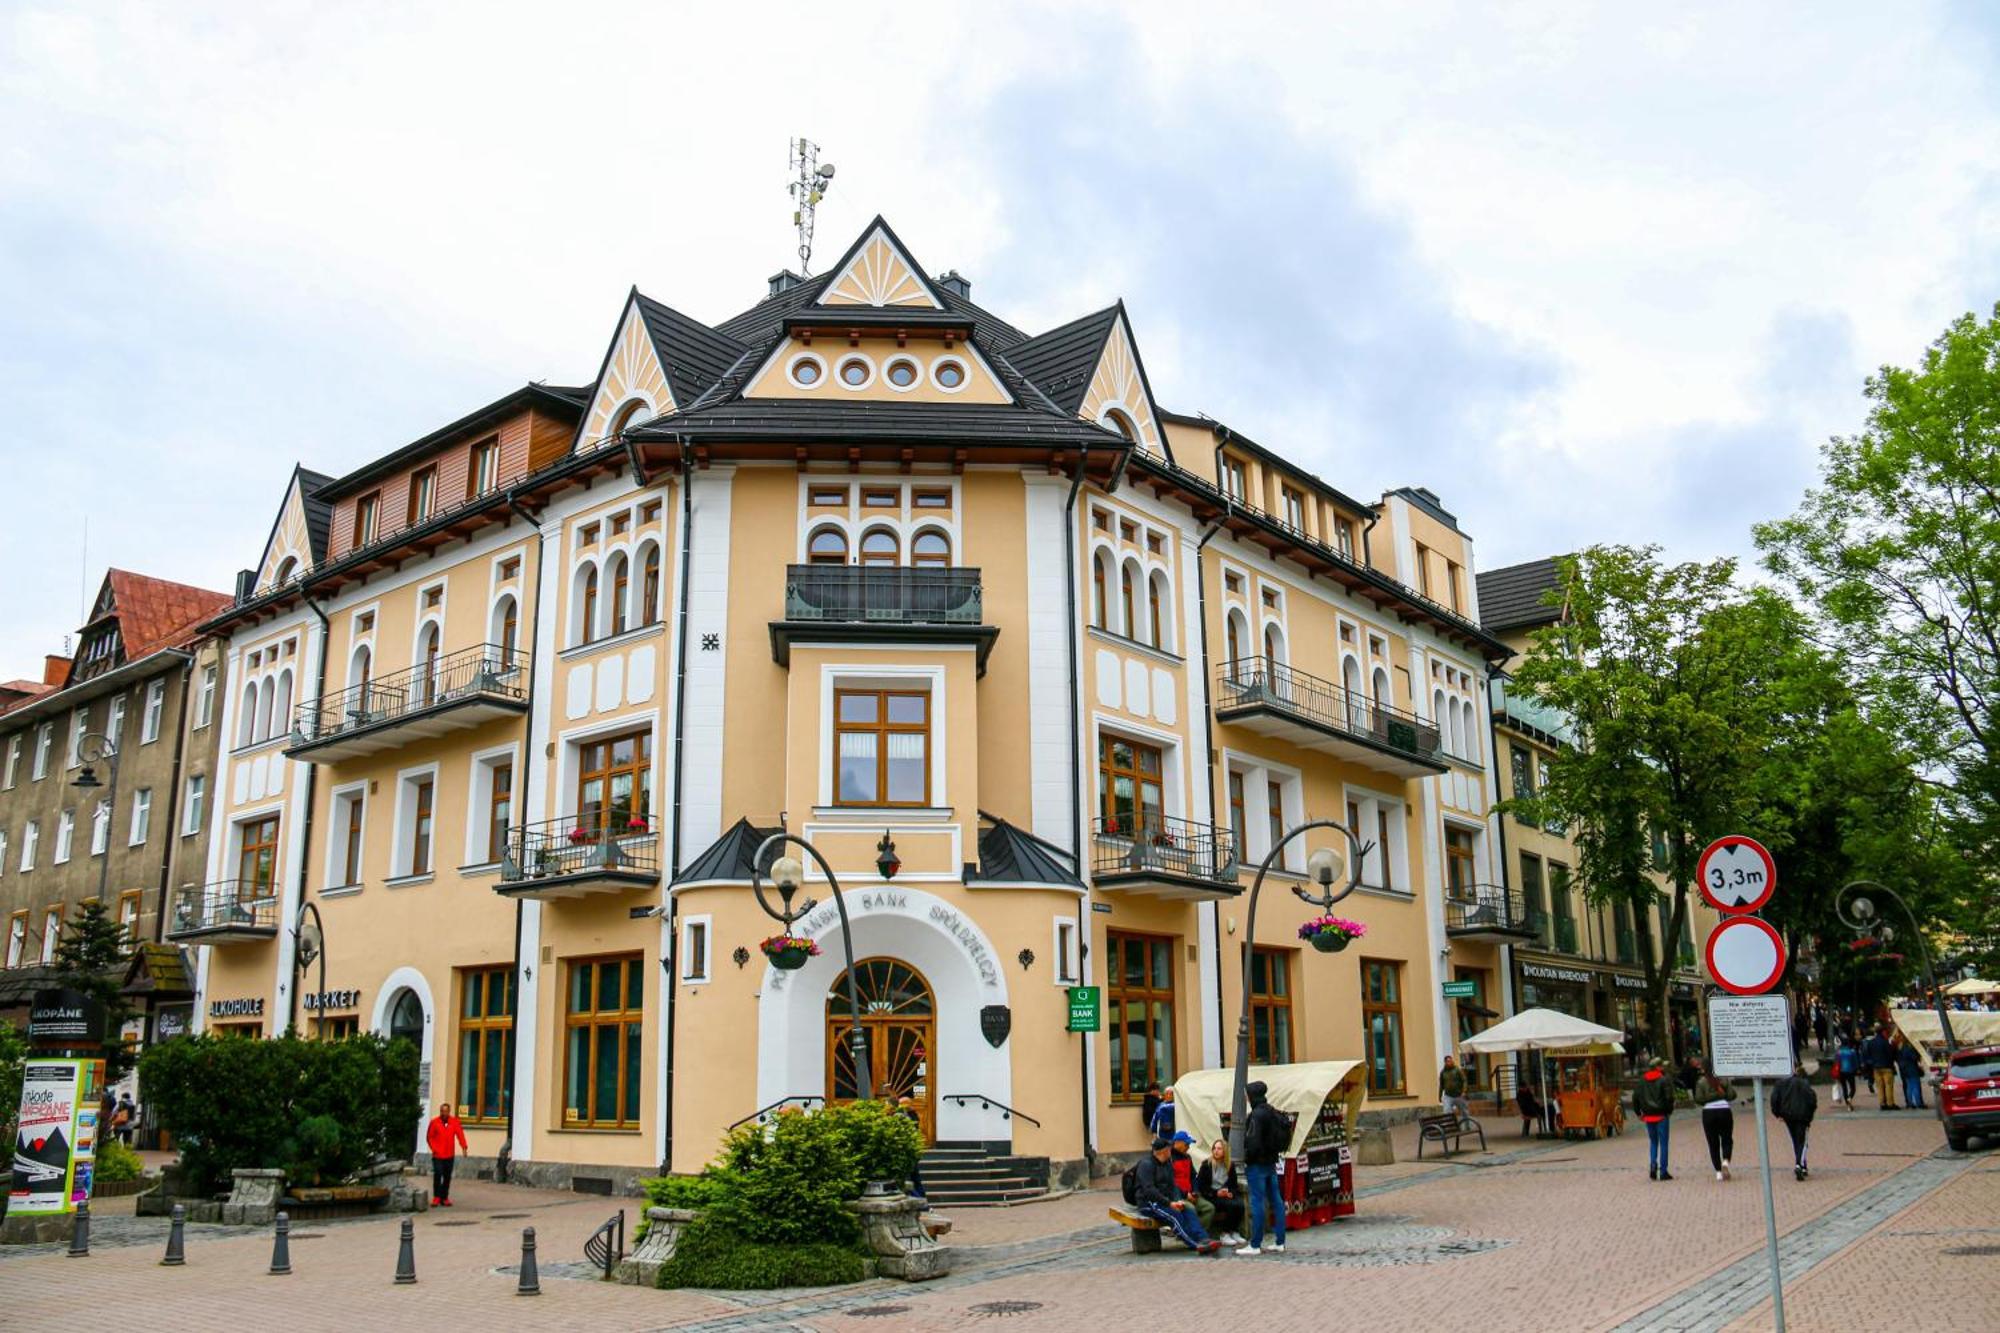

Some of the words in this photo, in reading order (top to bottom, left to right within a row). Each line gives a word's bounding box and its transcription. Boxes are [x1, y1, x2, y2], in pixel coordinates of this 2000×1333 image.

[1711, 868, 1763, 890] 3,3m
[862, 892, 907, 909] BANK
[929, 904, 998, 988] SPÓŁDZIELCZY
[1527, 965, 1557, 980] MOUNTAIN
[210, 998, 264, 1017] ALKOHOLE
[304, 990, 360, 1009] MARKET
[32, 1006, 83, 1018] AKOPANE
[1072, 1009, 1093, 1017] BANK
